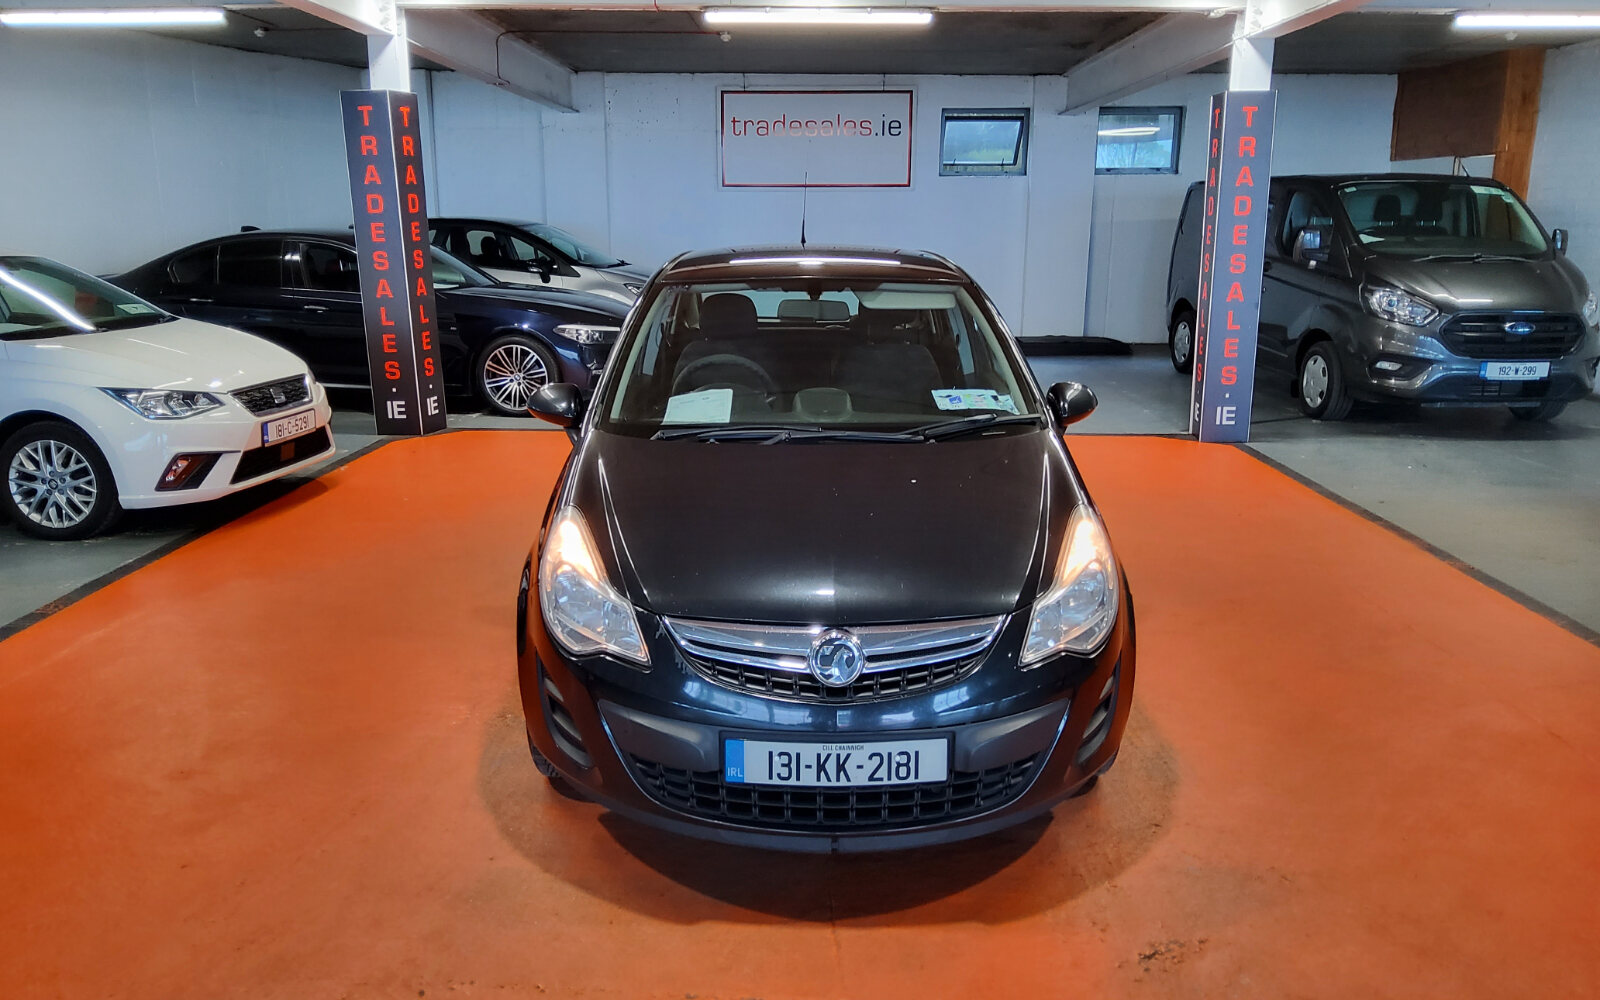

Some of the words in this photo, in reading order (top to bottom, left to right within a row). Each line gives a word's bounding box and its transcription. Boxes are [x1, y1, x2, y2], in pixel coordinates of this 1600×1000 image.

[731, 114, 902, 137] tradesales.ie
[357, 105, 407, 420] TRADESALES.IE
[399, 106, 439, 416] TRADESALES.IE
[1215, 106, 1258, 425] TRADESALES.IE
[1498, 365, 1537, 376] 192-W-299
[275, 415, 310, 438] 181-C-5291
[727, 767, 744, 778] IRL
[768, 750, 920, 783] 131-KK-2181
